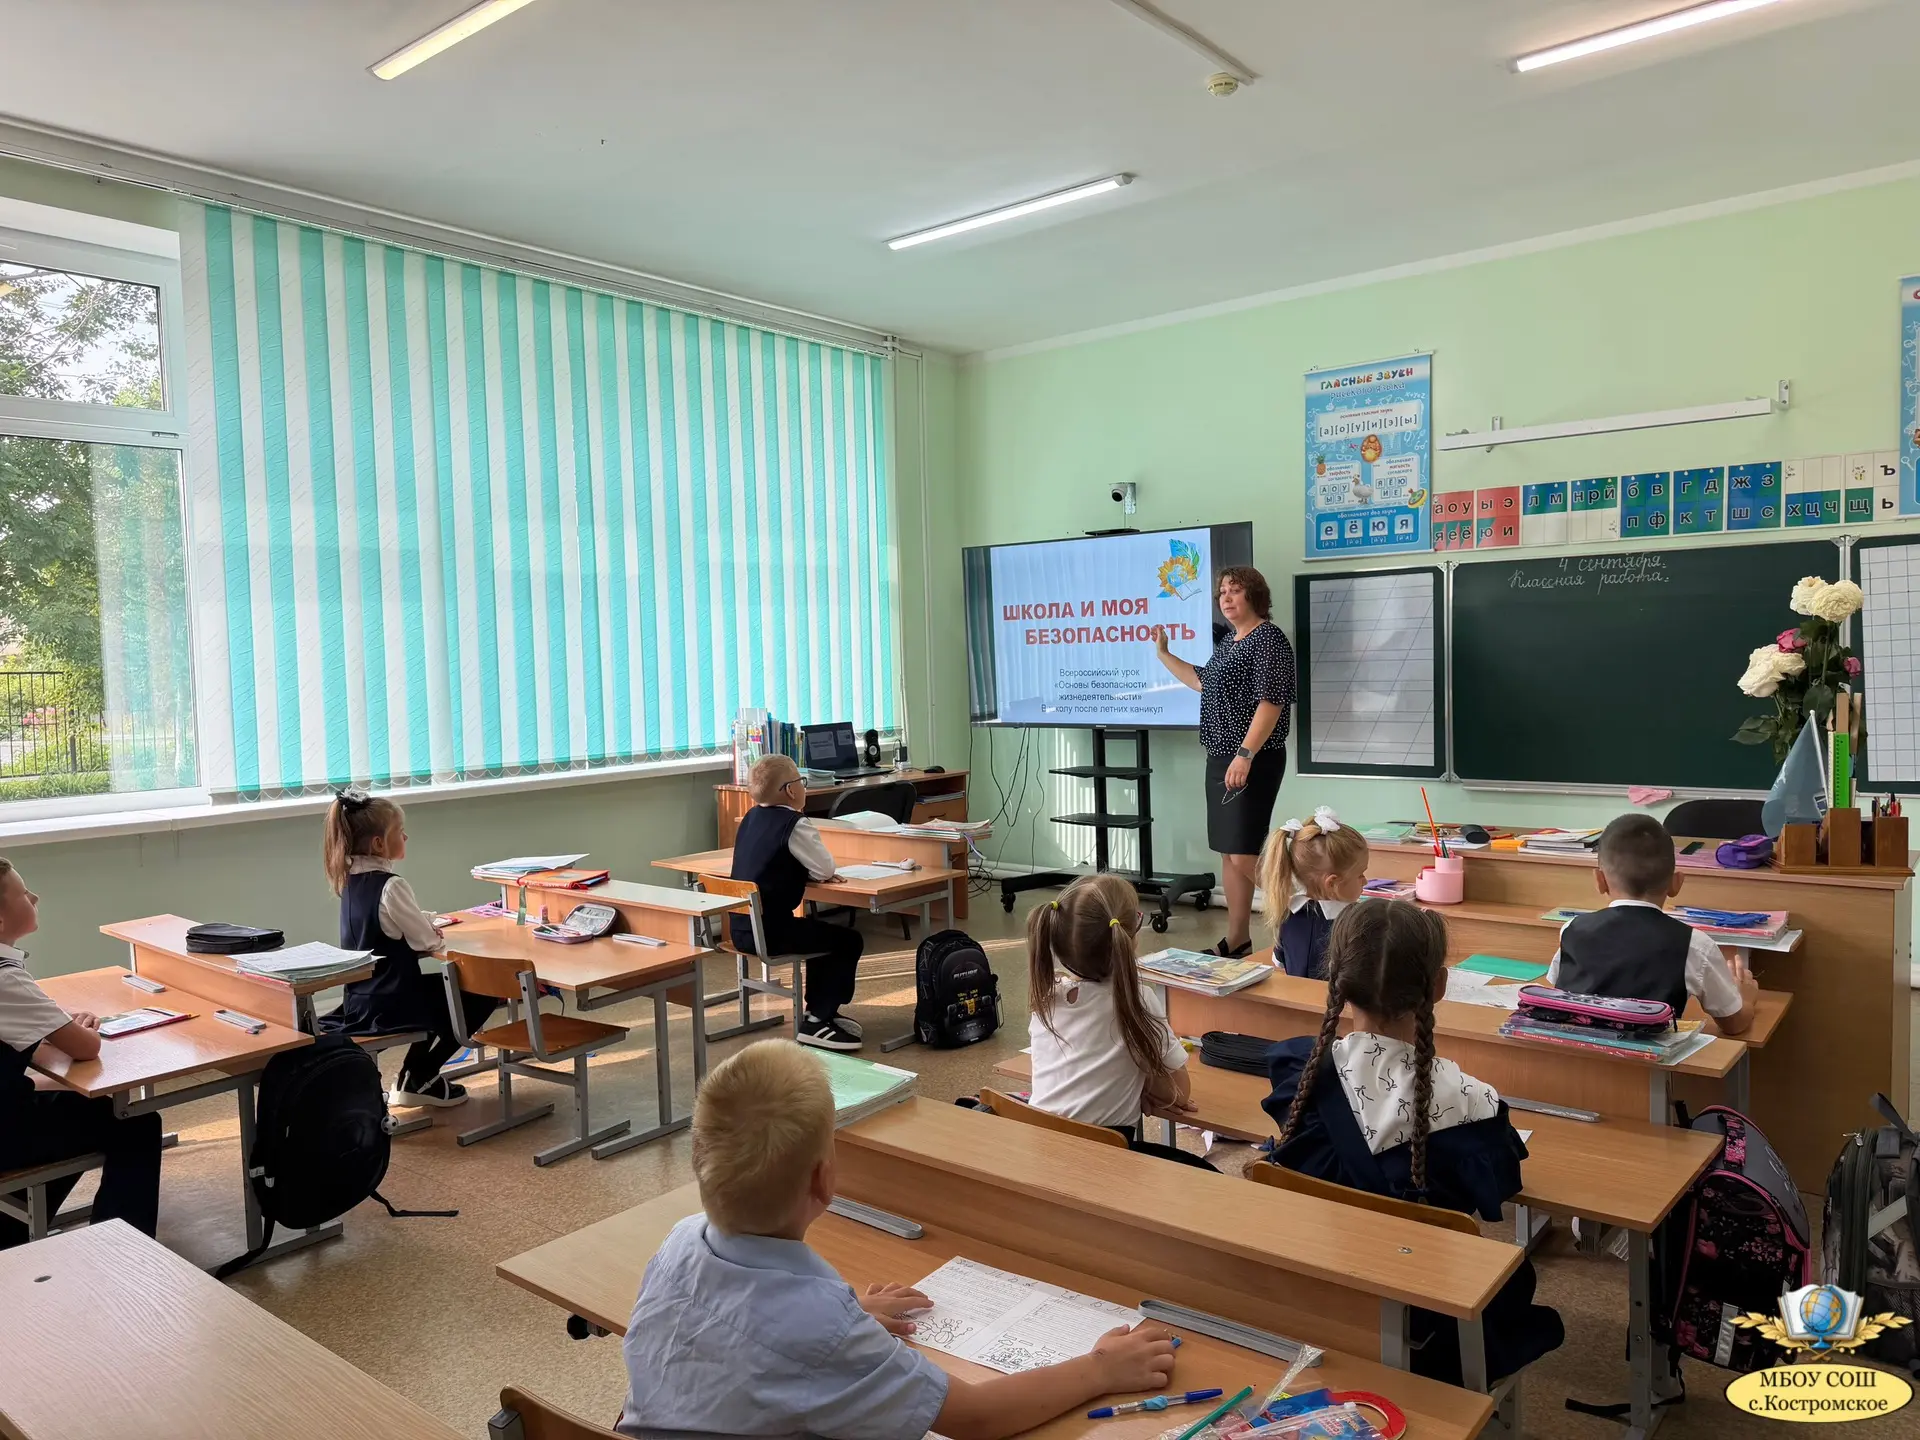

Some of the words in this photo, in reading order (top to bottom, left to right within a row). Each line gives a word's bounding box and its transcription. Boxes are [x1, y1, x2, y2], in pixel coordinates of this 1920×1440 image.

[1320, 374, 1373, 390] ГЛАСНЫЕ
[1376, 368, 1414, 381] ЗВУКИ
[1325, 526, 1333, 536] е
[1349, 520, 1358, 533] ё
[1372, 521, 1386, 531] ю
[1400, 519, 1408, 529] я
[1558, 558, 1568, 572] 4
[1508, 569, 1585, 588] Классная
[1002, 601, 1075, 622] ШКОЛА
[1080, 600, 1096, 618] И
[1102, 598, 1149, 616] МОЯ
[1025, 622, 1196, 646] БЕЗОПАСНОТЬ
[1060, 668, 1120, 678] Всероссийский
[1121, 669, 1140, 678] урок
[1091, 680, 1147, 689] безопасности
[1048, 705, 1072, 714] колу
[1130, 706, 1164, 714] каникул
